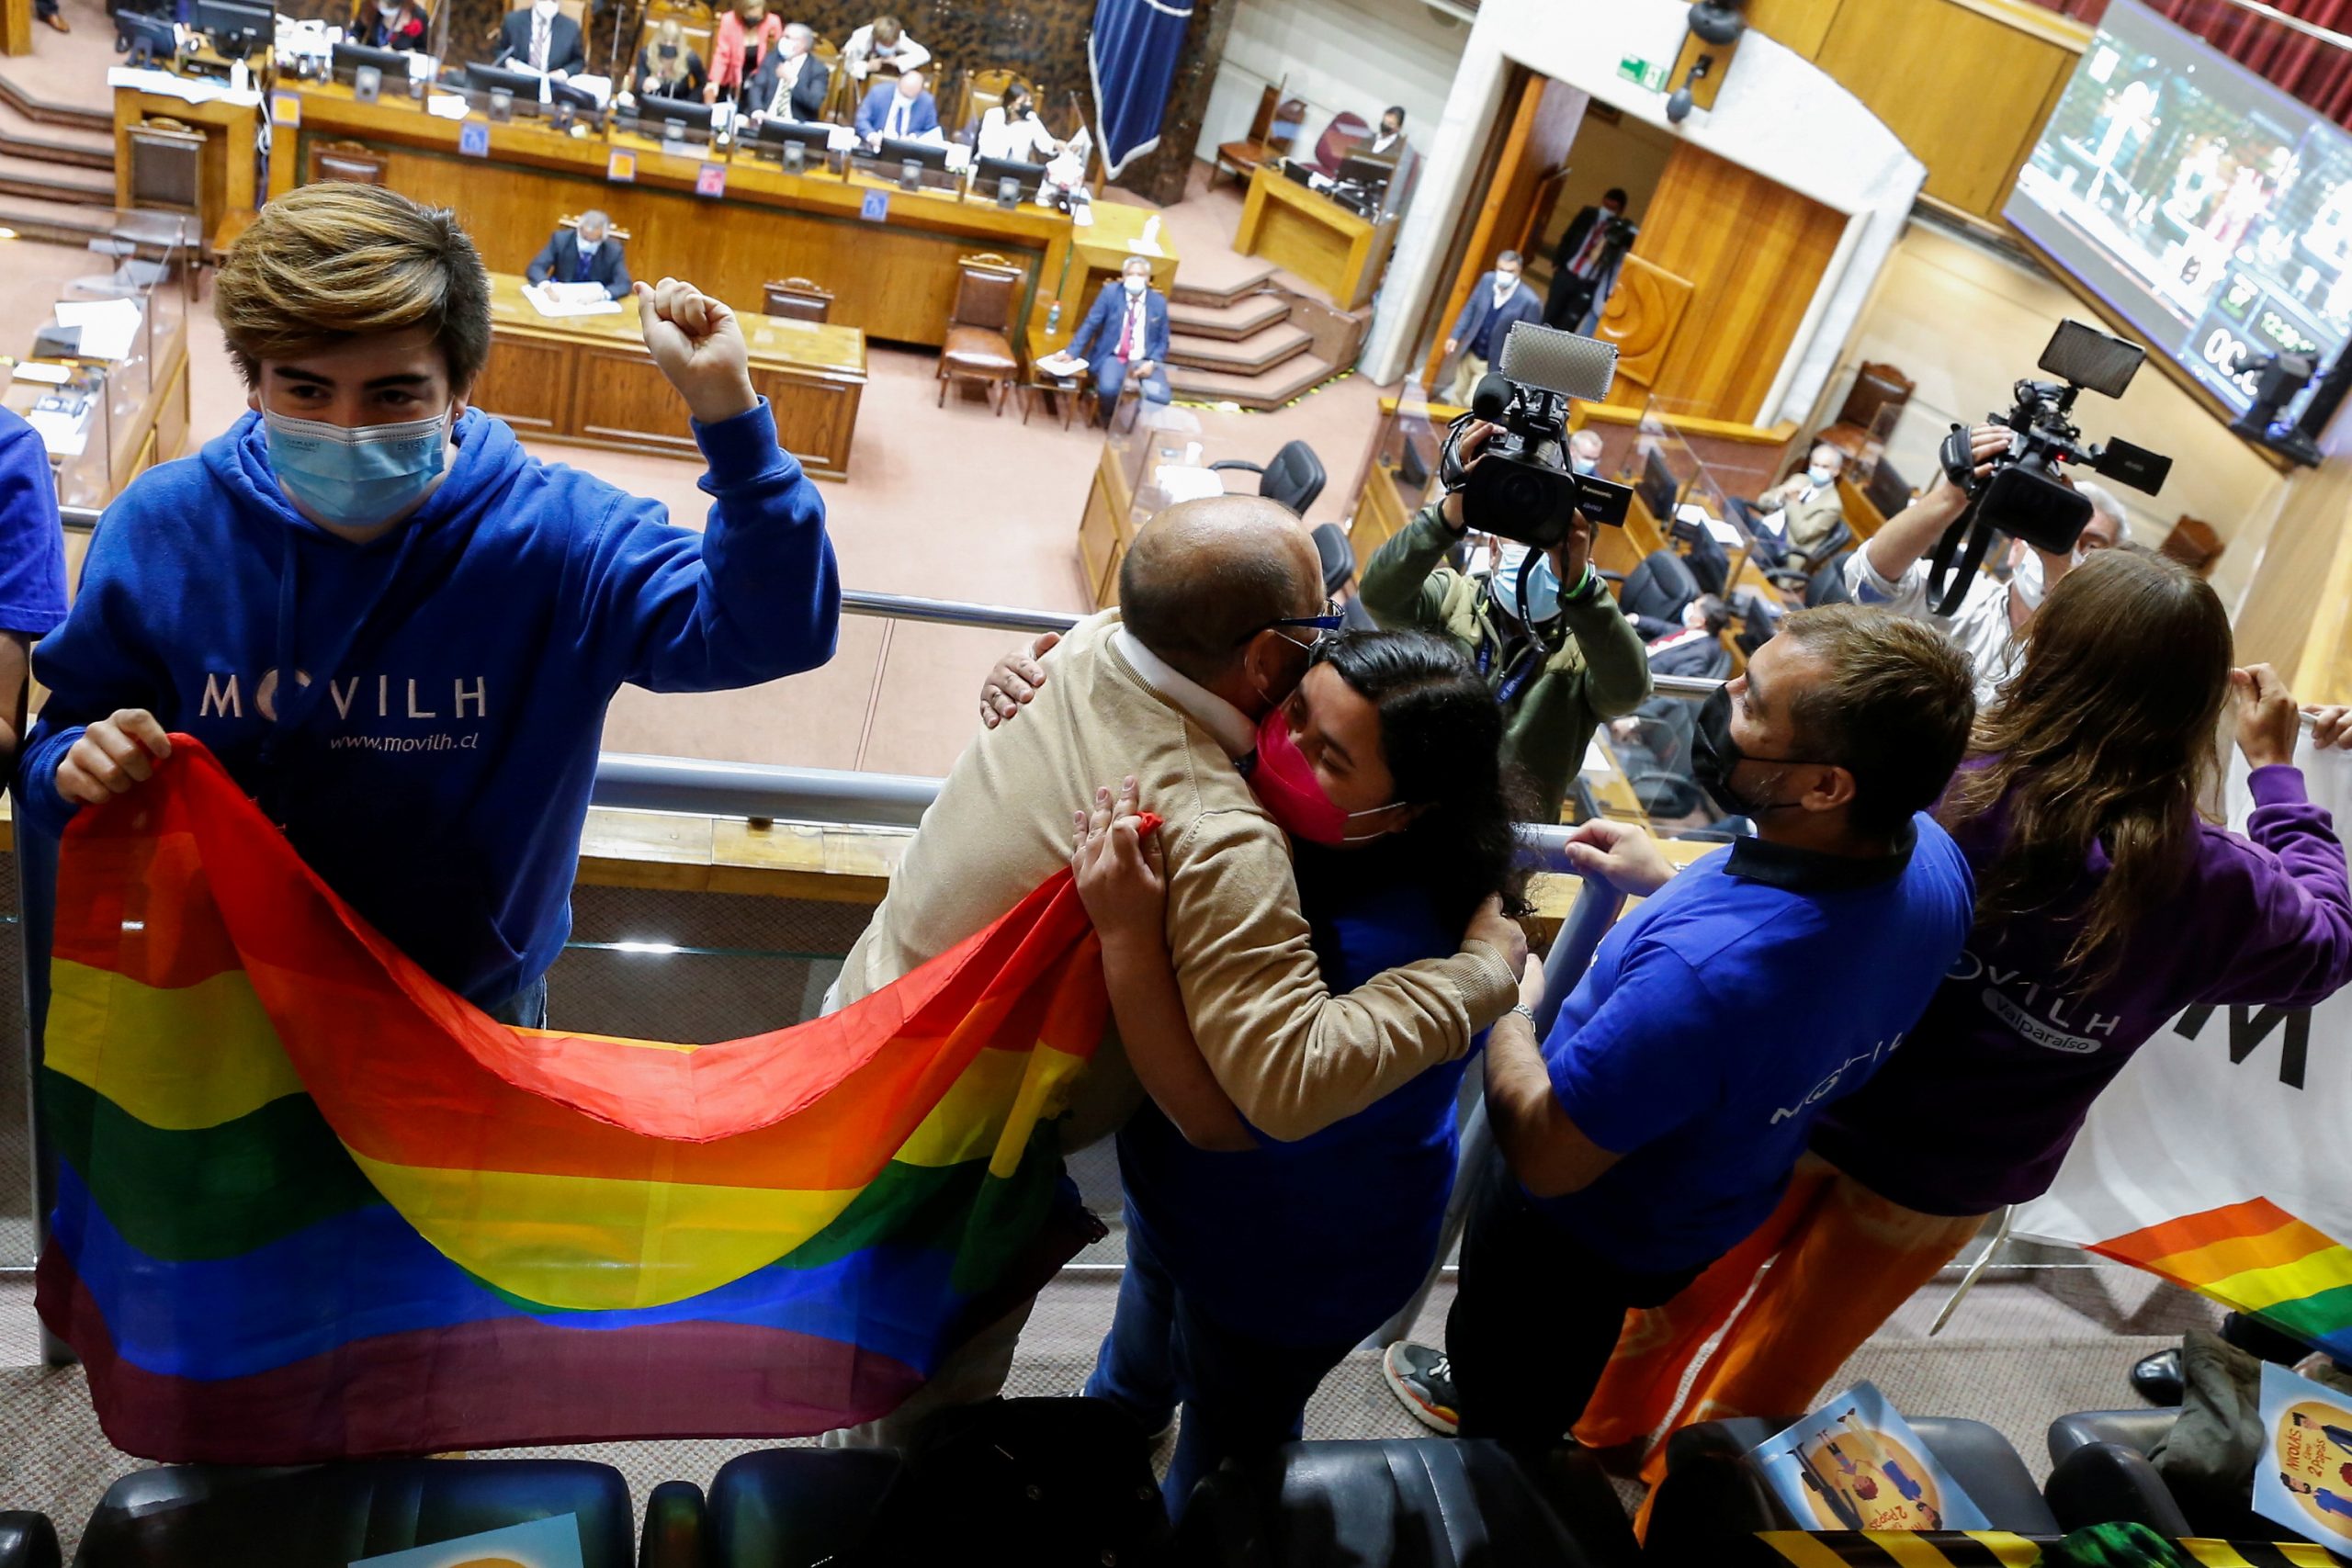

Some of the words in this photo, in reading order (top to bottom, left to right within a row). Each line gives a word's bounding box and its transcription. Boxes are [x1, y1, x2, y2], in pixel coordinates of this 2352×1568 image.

[330, 732, 479, 751] www.movilh.cl
[1996, 993, 2090, 1052] Valparaíso
[2307, 1466, 2323, 1477] 2
[1894, 1505, 1908, 1519] 2
